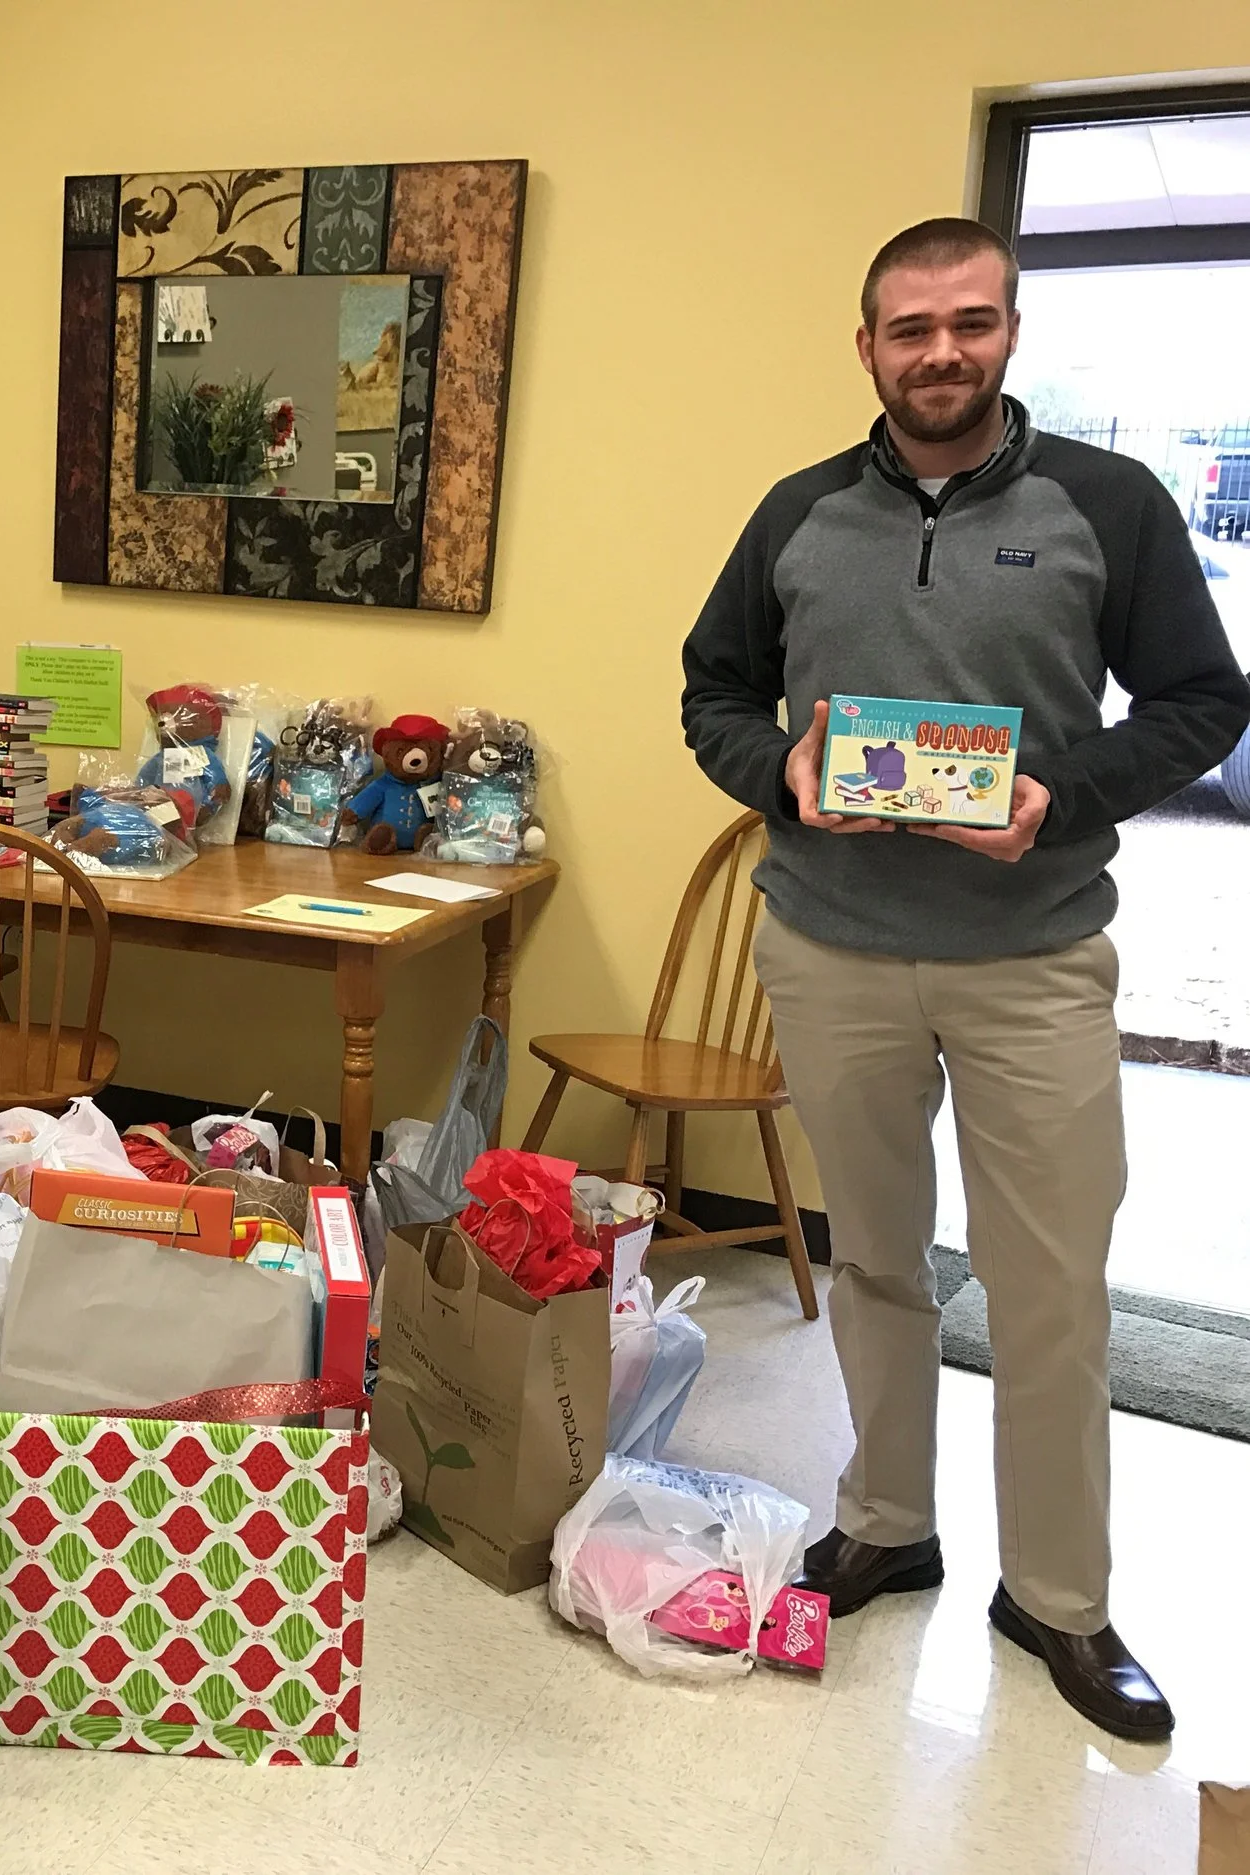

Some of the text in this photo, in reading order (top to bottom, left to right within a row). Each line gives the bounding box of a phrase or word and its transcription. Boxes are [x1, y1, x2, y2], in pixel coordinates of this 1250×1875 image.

[851, 718, 1011, 752] ENGLISH & SPANISH
[74, 1207, 183, 1224] CURIOSITIES
[77, 1198, 114, 1210] CLASSIC
[326, 1207, 344, 1221] ART
[328, 1223, 349, 1247] COLOR
[396, 1322, 413, 1342] Our
[410, 1344, 462, 1398] 100% Recycled
[550, 1333, 570, 1391] Paper
[463, 1401, 492, 1426] Paper
[469, 1414, 488, 1436] Bag
[557, 1393, 585, 1487] Recycled
[785, 1593, 821, 1658] Barbie
